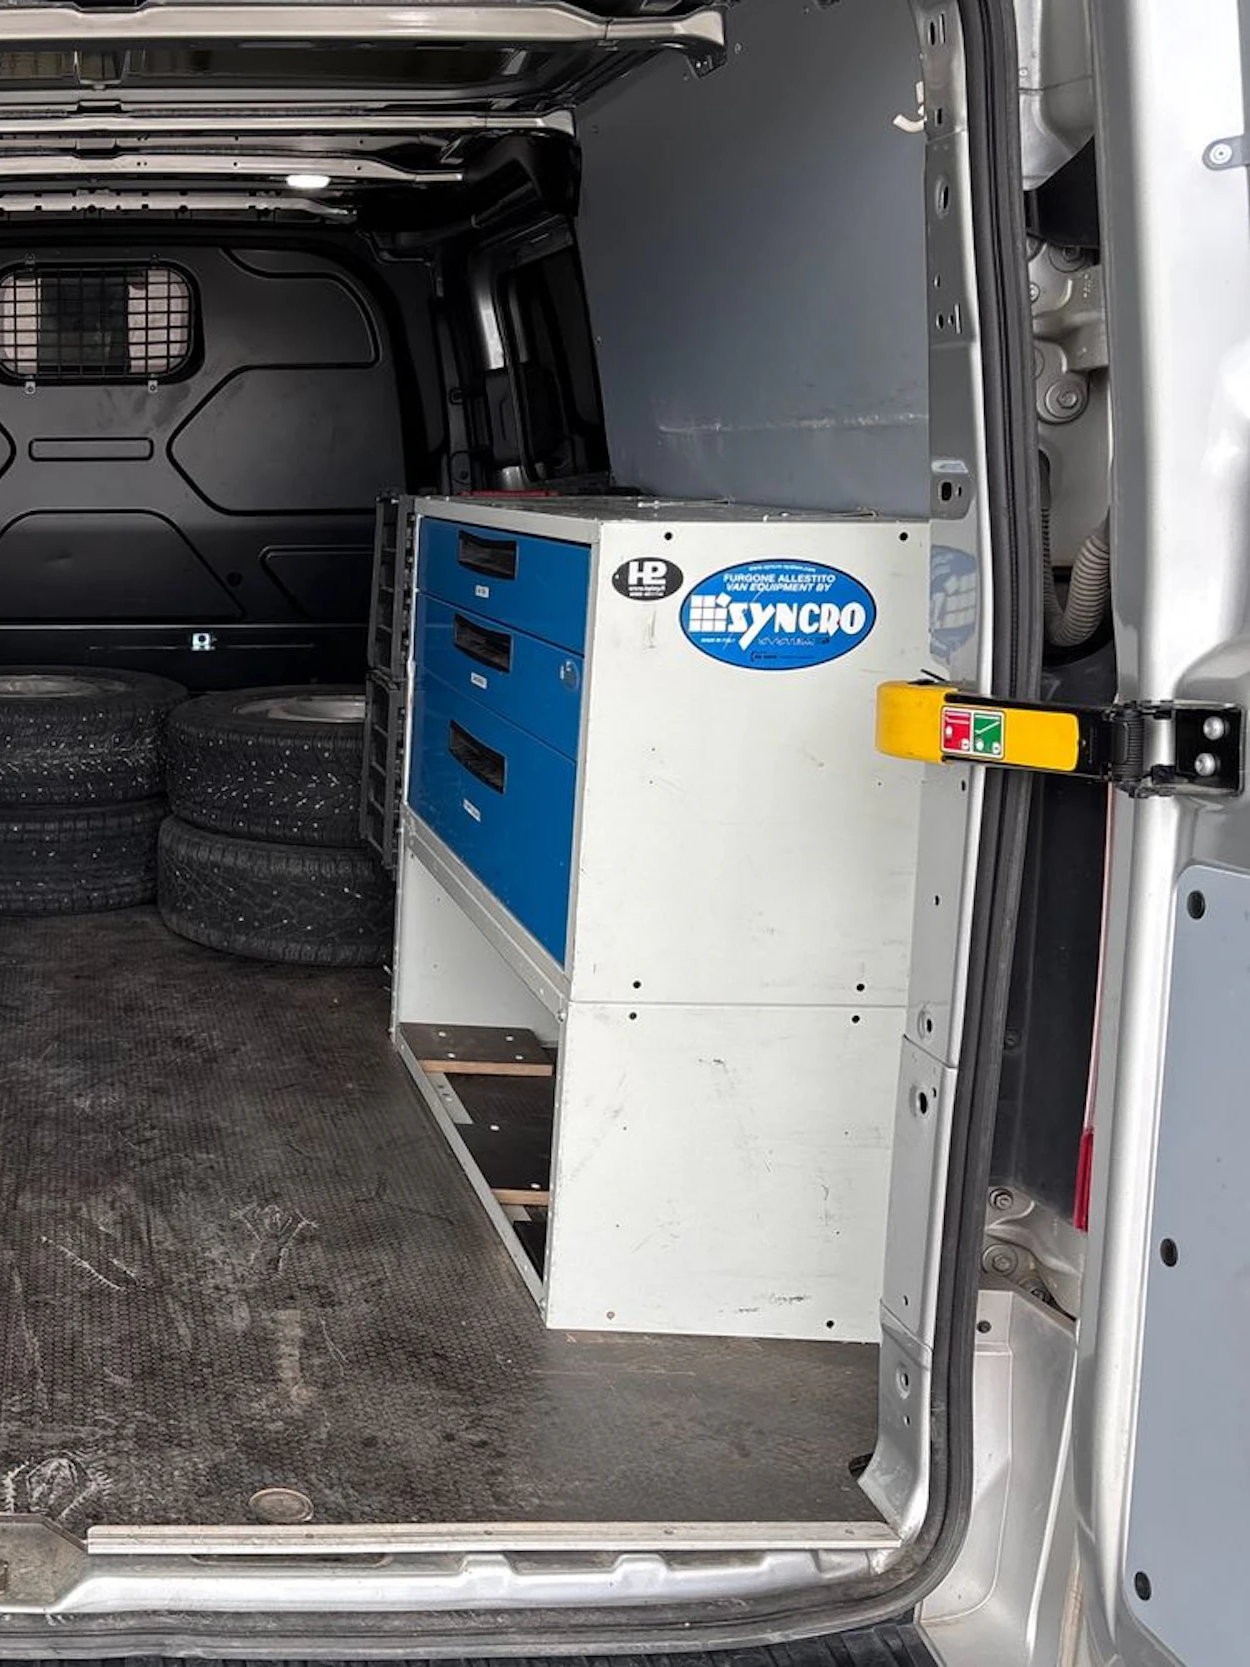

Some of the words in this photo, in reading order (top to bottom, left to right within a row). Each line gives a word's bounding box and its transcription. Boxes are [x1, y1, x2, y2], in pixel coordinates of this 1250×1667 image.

[723, 573, 776, 583] FURGONE
[777, 573, 836, 584] ALLESTITO
[726, 582, 749, 592] VAN
[749, 582, 815, 593] EQUIPMENT
[815, 582, 832, 593] BY
[727, 602, 867, 651] SYNCRO
